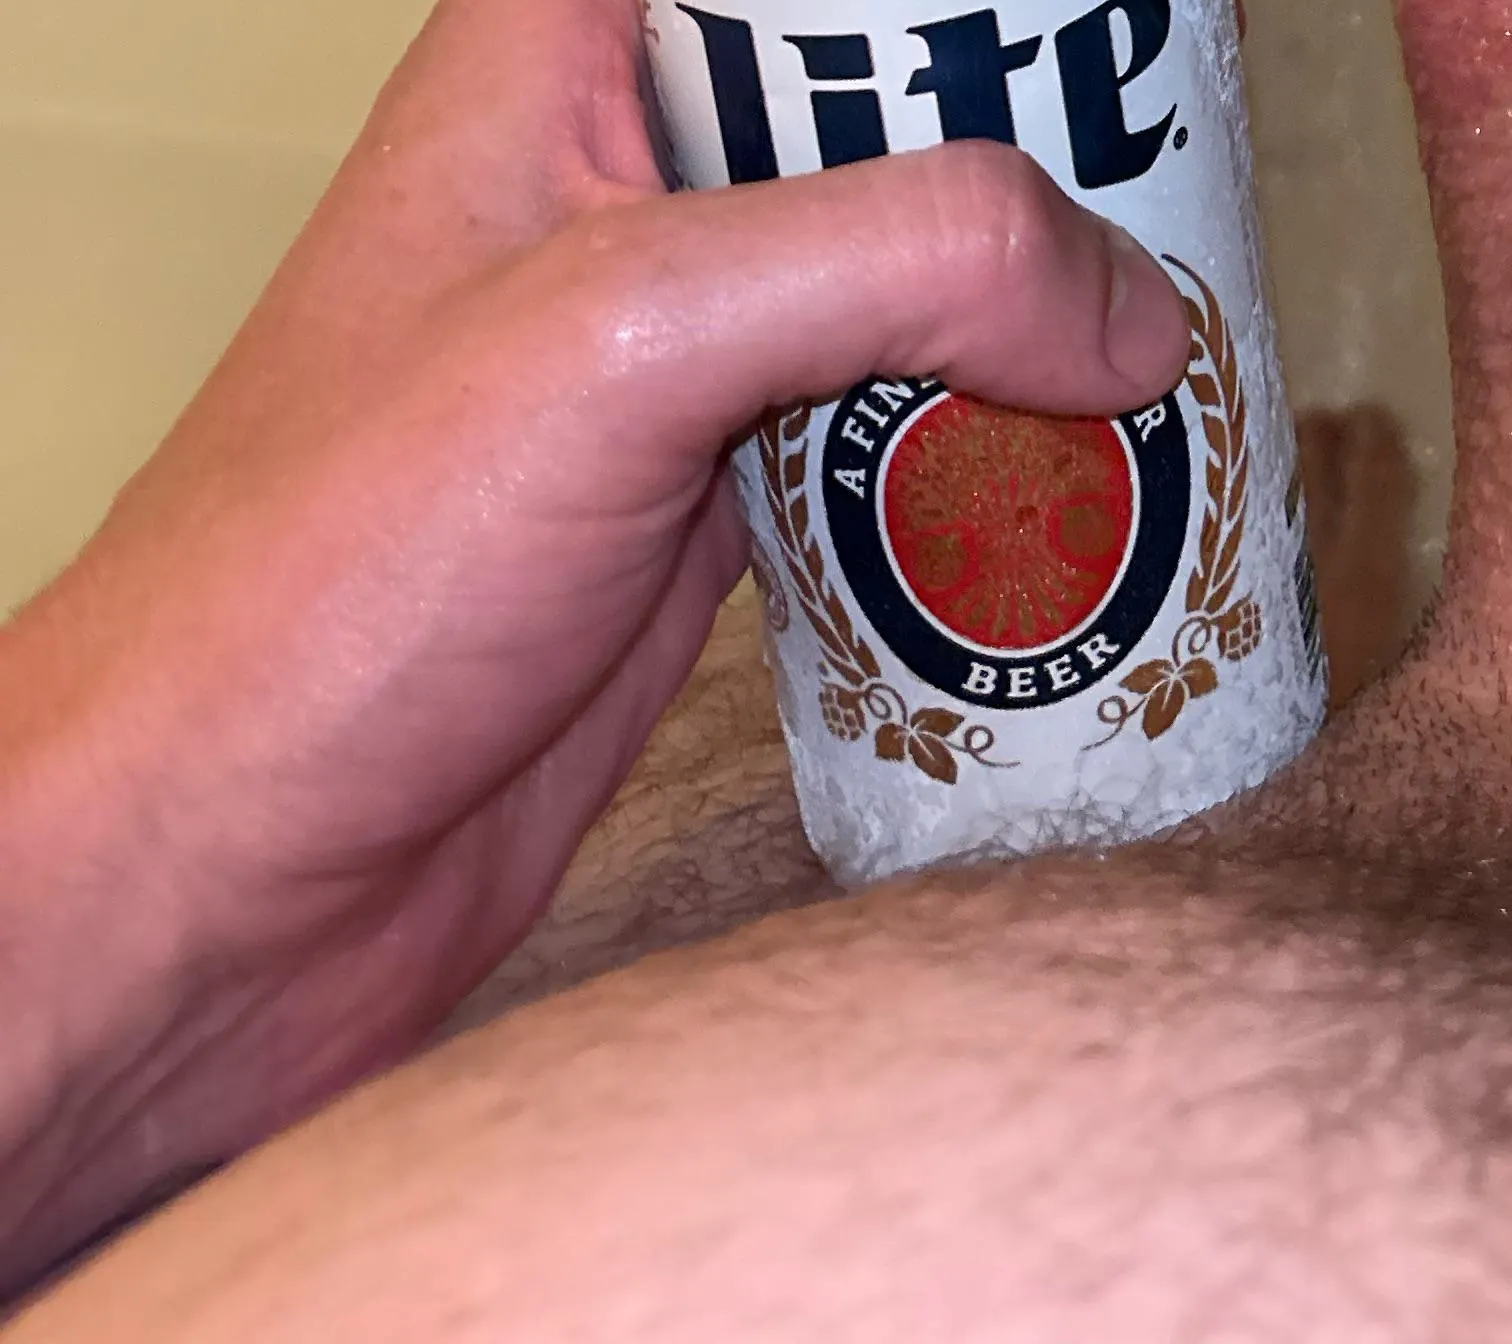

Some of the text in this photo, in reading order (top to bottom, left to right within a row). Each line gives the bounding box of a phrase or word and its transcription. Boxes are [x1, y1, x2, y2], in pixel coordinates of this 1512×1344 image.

[834, 377, 940, 500] A FIN
[961, 632, 1121, 699] BEER
